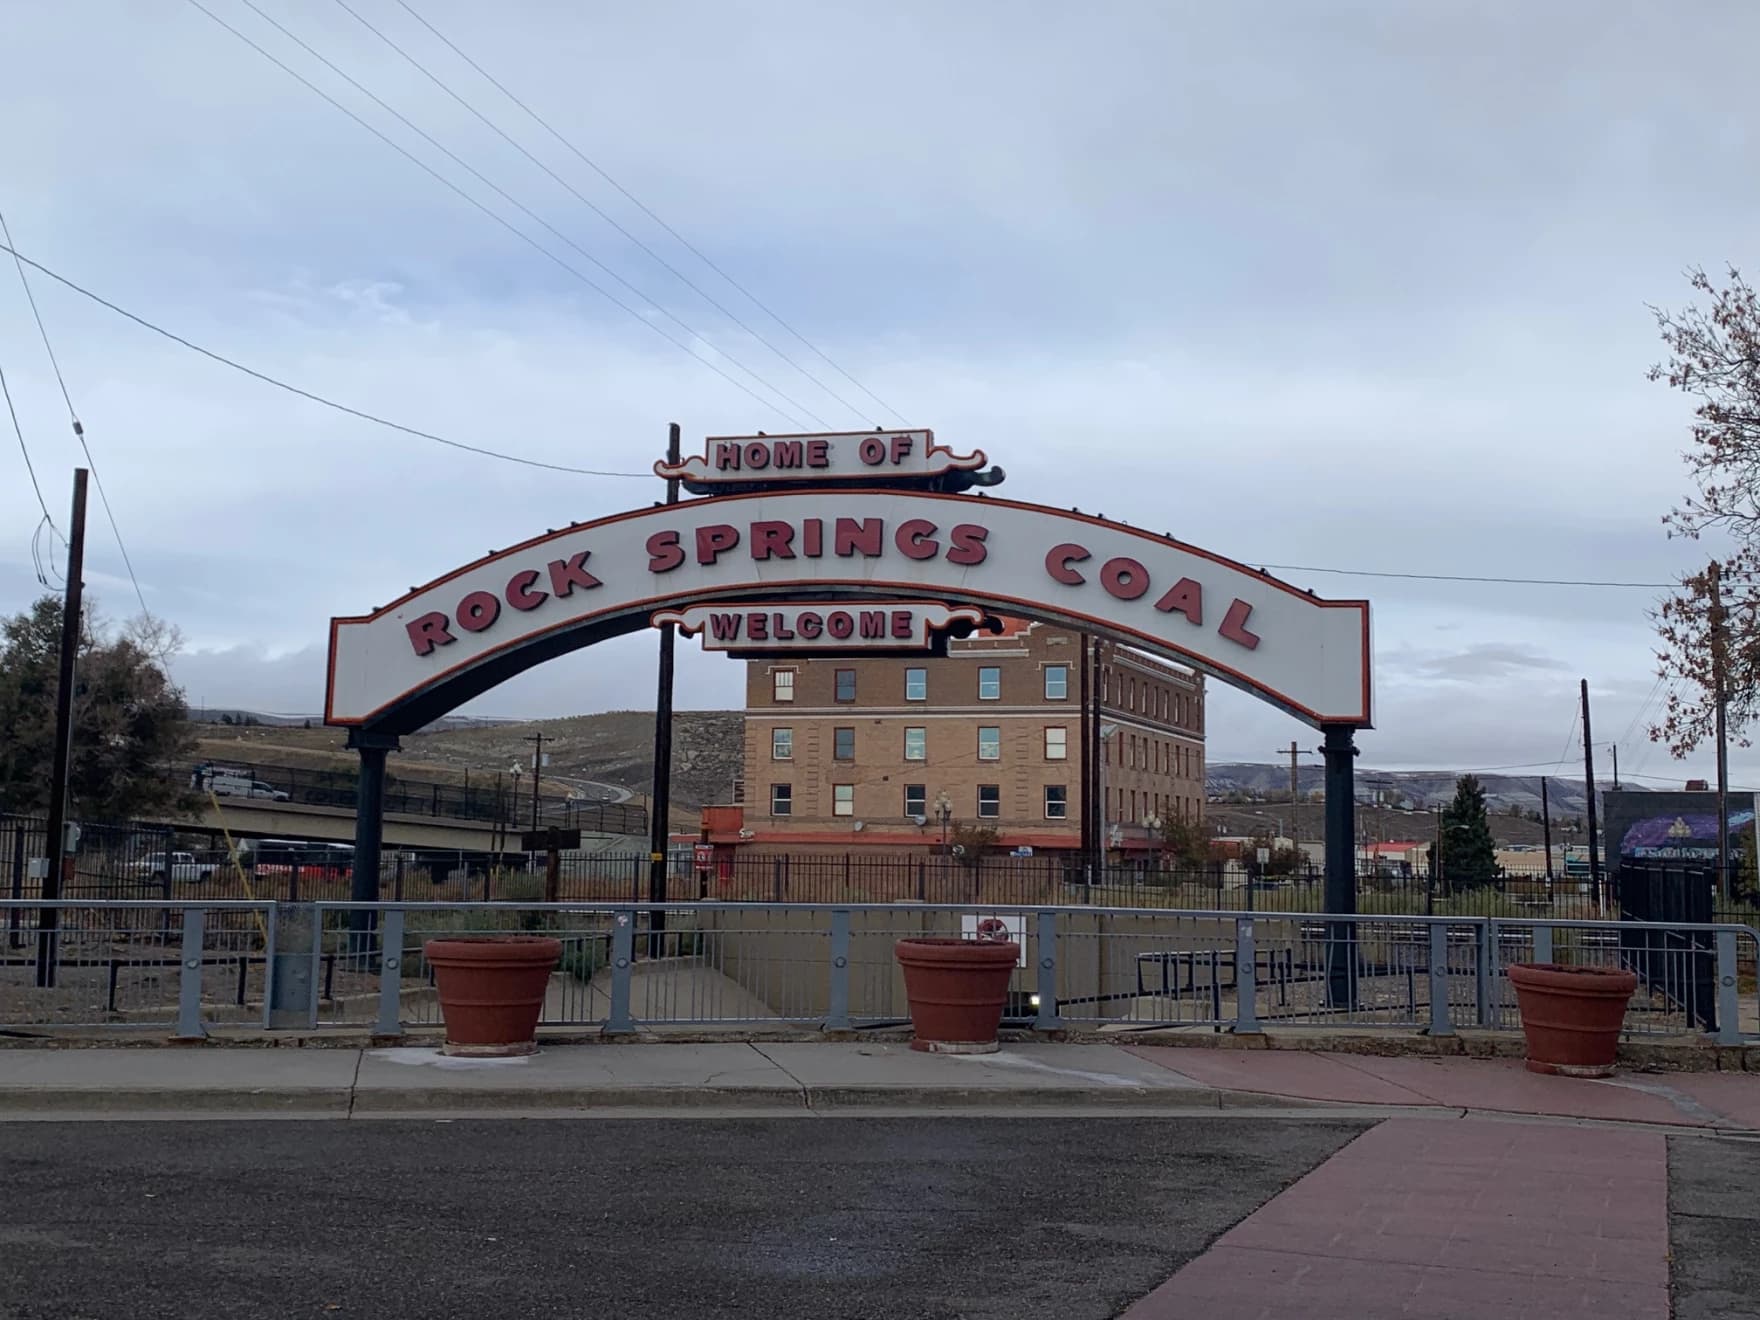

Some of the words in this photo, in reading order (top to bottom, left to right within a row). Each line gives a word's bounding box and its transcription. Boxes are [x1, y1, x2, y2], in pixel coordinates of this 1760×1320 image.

[716, 440, 829, 469] HOME
[860, 435, 912, 466] OF
[406, 551, 603, 656] ROCK
[646, 518, 989, 573] SPRINGS
[1045, 543, 1260, 650] COAL
[710, 611, 912, 640] WELCOME
